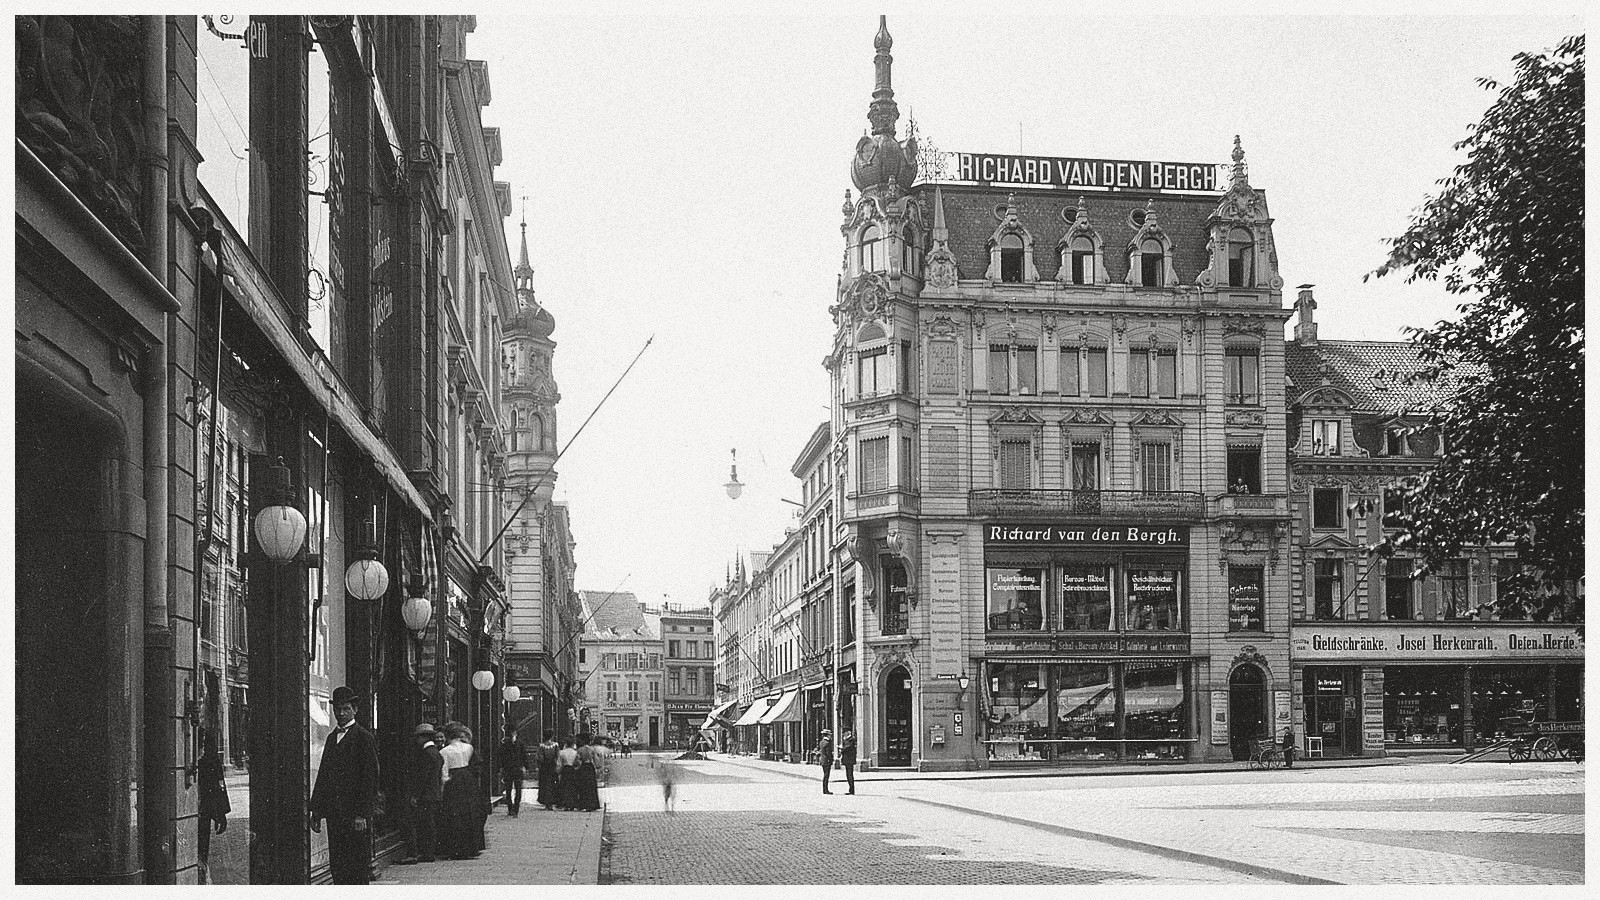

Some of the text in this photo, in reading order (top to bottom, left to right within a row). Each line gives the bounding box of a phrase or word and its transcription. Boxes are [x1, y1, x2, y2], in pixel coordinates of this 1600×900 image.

[959, 153, 1216, 190] RICHARD VAN DEN BERGH
[990, 525, 1182, 545] Richard van den Bergh.
[1312, 634, 1388, 651] Geldschränke.
[1397, 634, 1427, 651] Josef
[1432, 633, 1498, 651] Herkenrath.
